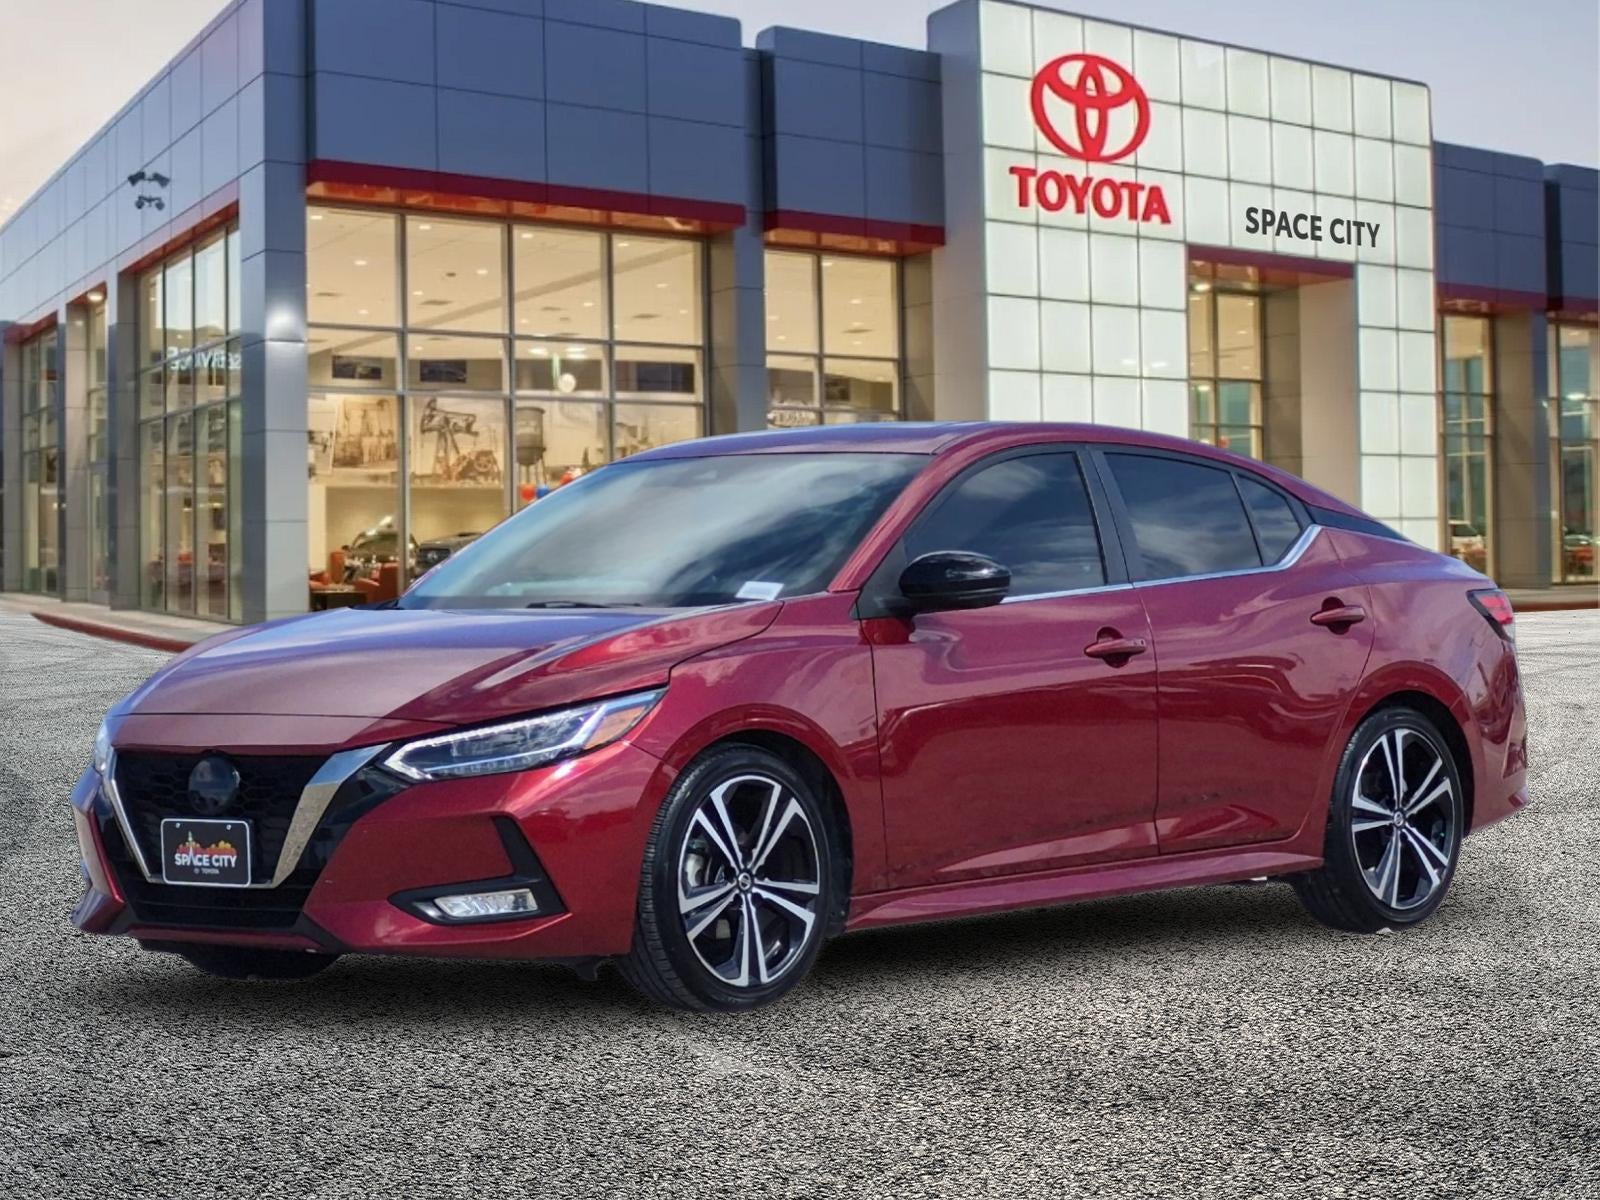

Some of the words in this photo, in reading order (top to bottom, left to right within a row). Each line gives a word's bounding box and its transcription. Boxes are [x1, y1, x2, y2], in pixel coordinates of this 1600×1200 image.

[1009, 166, 1171, 224] TOYOTA
[1245, 206, 1322, 241] SPACE
[1329, 218, 1380, 248] CITY
[174, 852, 210, 867] SPACE
[212, 854, 237, 868] CITY
